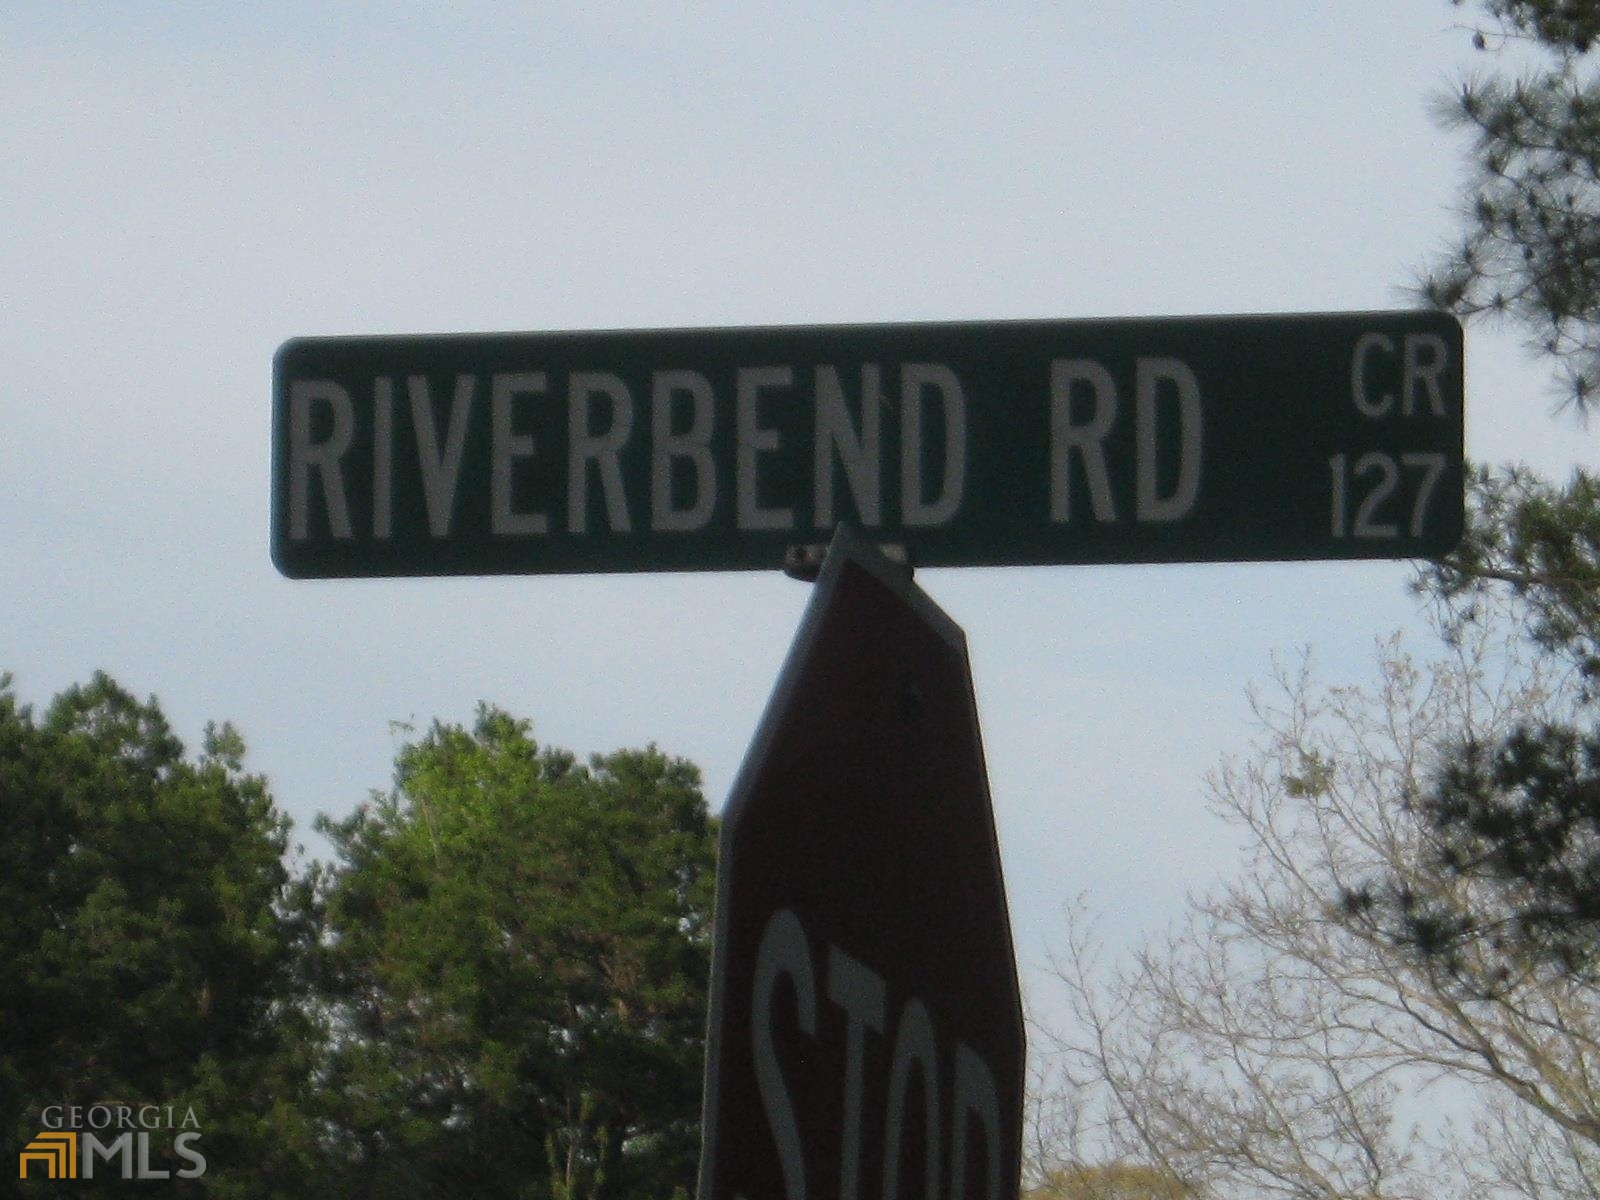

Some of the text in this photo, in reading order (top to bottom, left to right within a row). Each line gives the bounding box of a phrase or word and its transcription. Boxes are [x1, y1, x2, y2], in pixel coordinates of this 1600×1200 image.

[1351, 332, 1448, 417] CR
[288, 356, 1204, 540] RIVERBEND RD
[1328, 452, 1447, 538] 127
